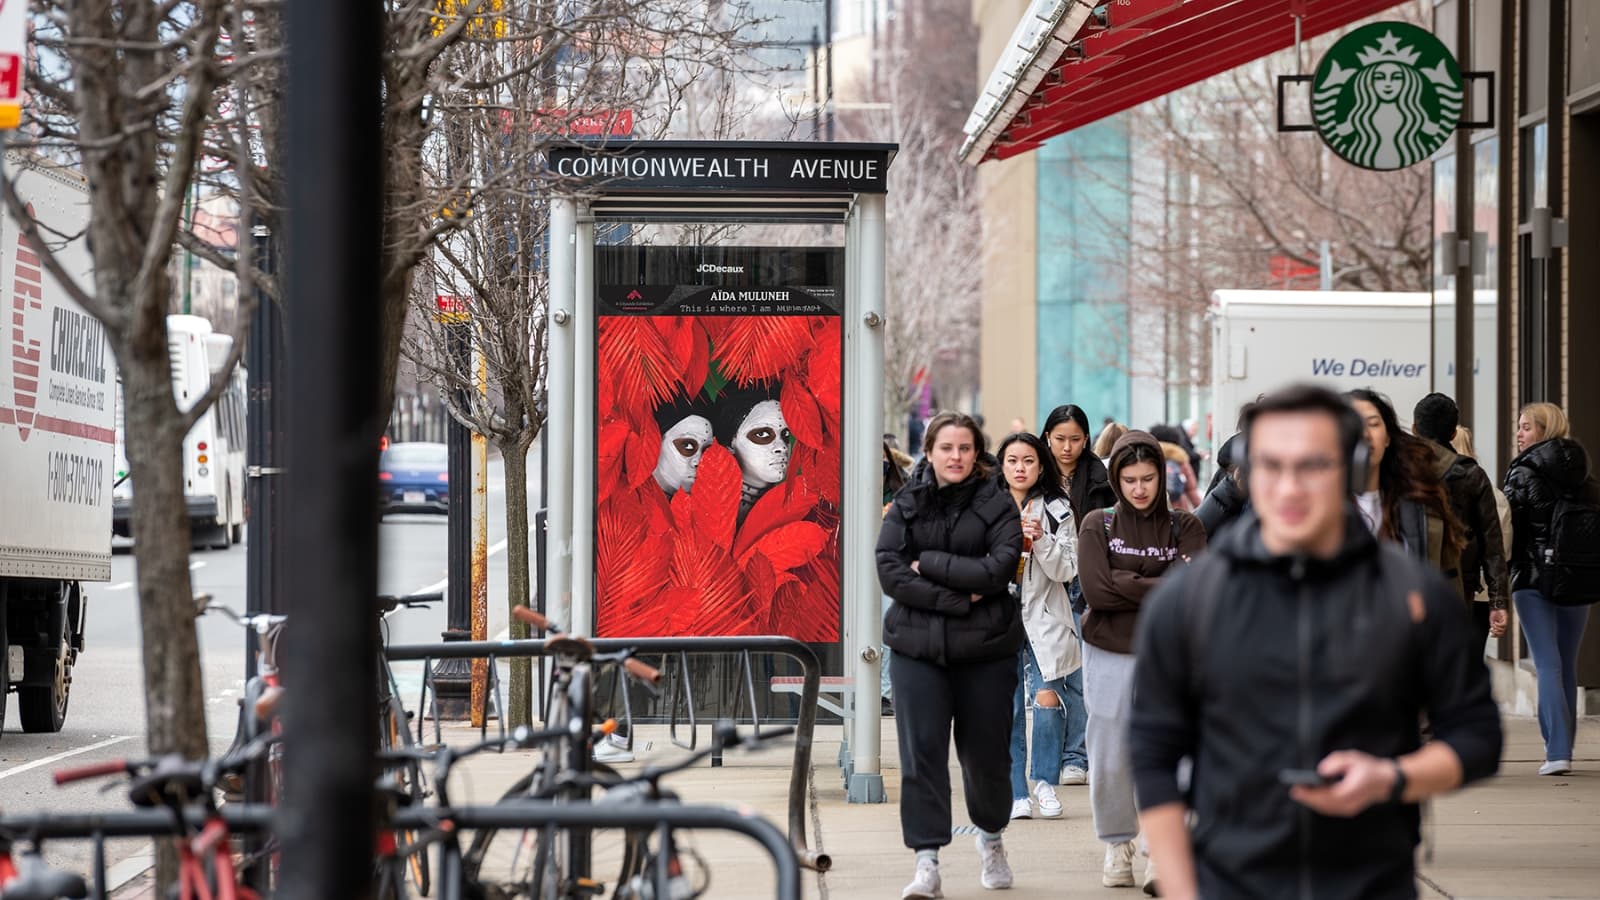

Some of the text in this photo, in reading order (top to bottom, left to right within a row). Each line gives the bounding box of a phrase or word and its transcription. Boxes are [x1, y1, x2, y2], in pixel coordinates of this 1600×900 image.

[557, 157, 878, 180] COMMONWEALTH AVENUE
[696, 263, 744, 273] JCDecaux
[710, 289, 790, 301] AÏDA MULUNEH
[680, 304, 701, 313] This
[705, 304, 715, 313] is
[720, 304, 747, 313] where
[751, 304, 756, 312] I
[760, 305, 771, 313] am
[50, 306, 106, 384] CHURCHILL
[1312, 358, 1345, 376] We
[1350, 358, 1426, 377] Deliver
